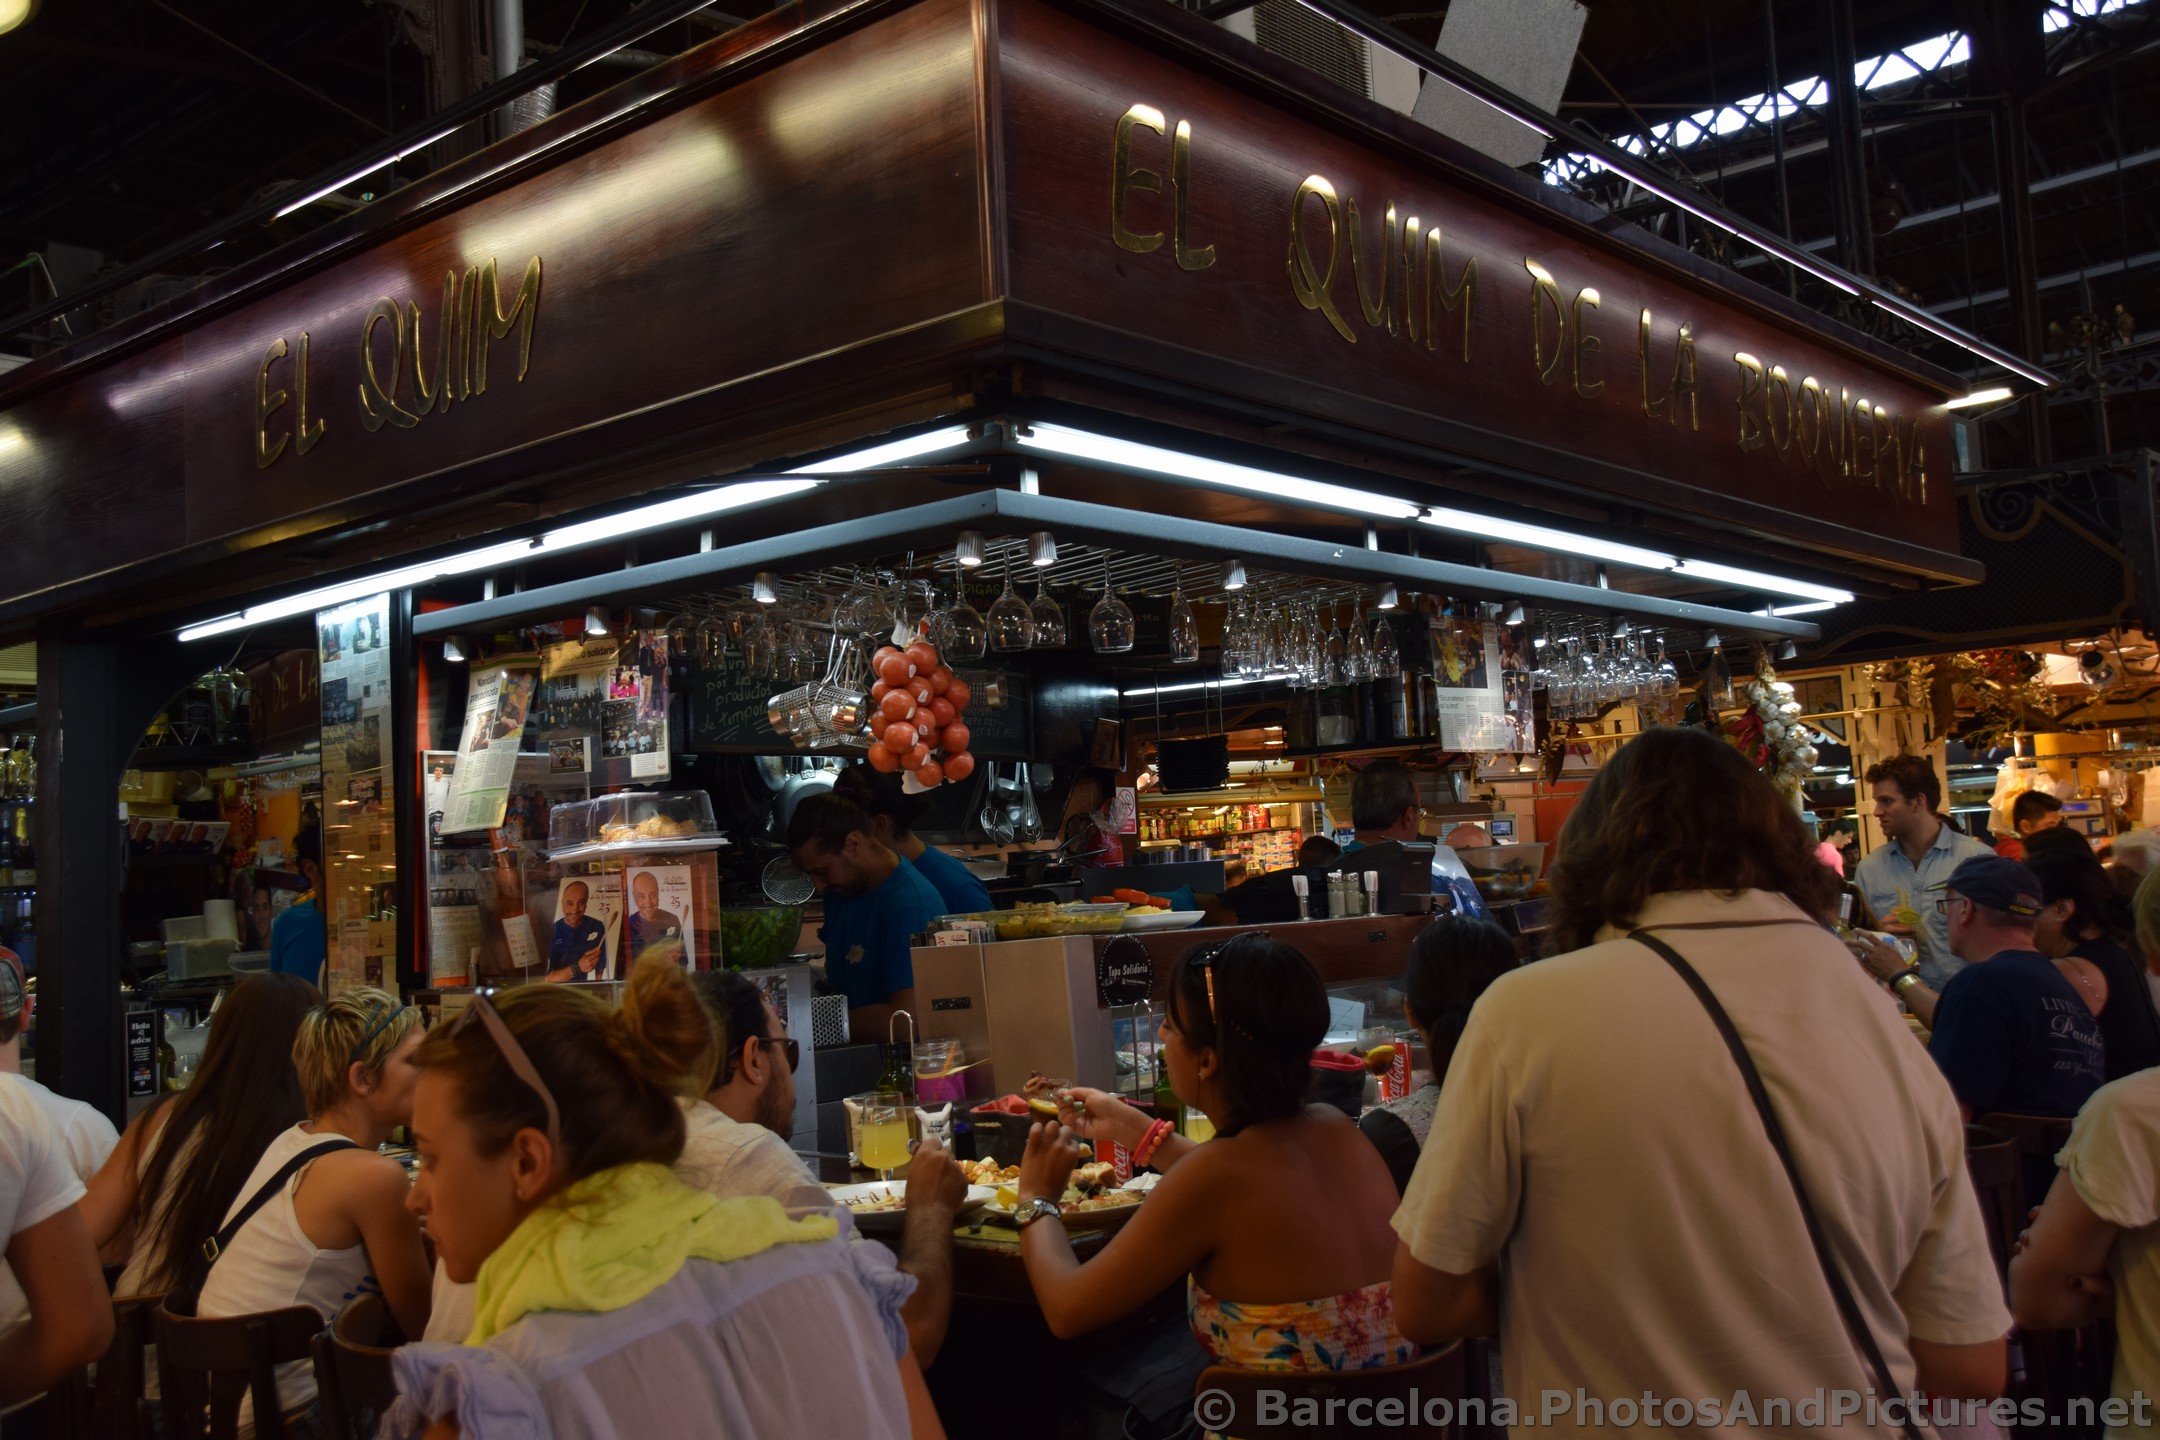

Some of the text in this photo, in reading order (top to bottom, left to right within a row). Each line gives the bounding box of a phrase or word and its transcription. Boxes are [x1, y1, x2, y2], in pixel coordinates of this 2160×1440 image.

[1111, 103, 1929, 507] EL QUIM DE LA BOQUERIA
[256, 254, 542, 469] EL QUIM
[715, 681, 773, 713] productos
[598, 902, 611, 914] 25
[670, 895, 681, 909] 25
[1108, 965, 1121, 980] Tapa
[131, 1022, 151, 1030] Hola
